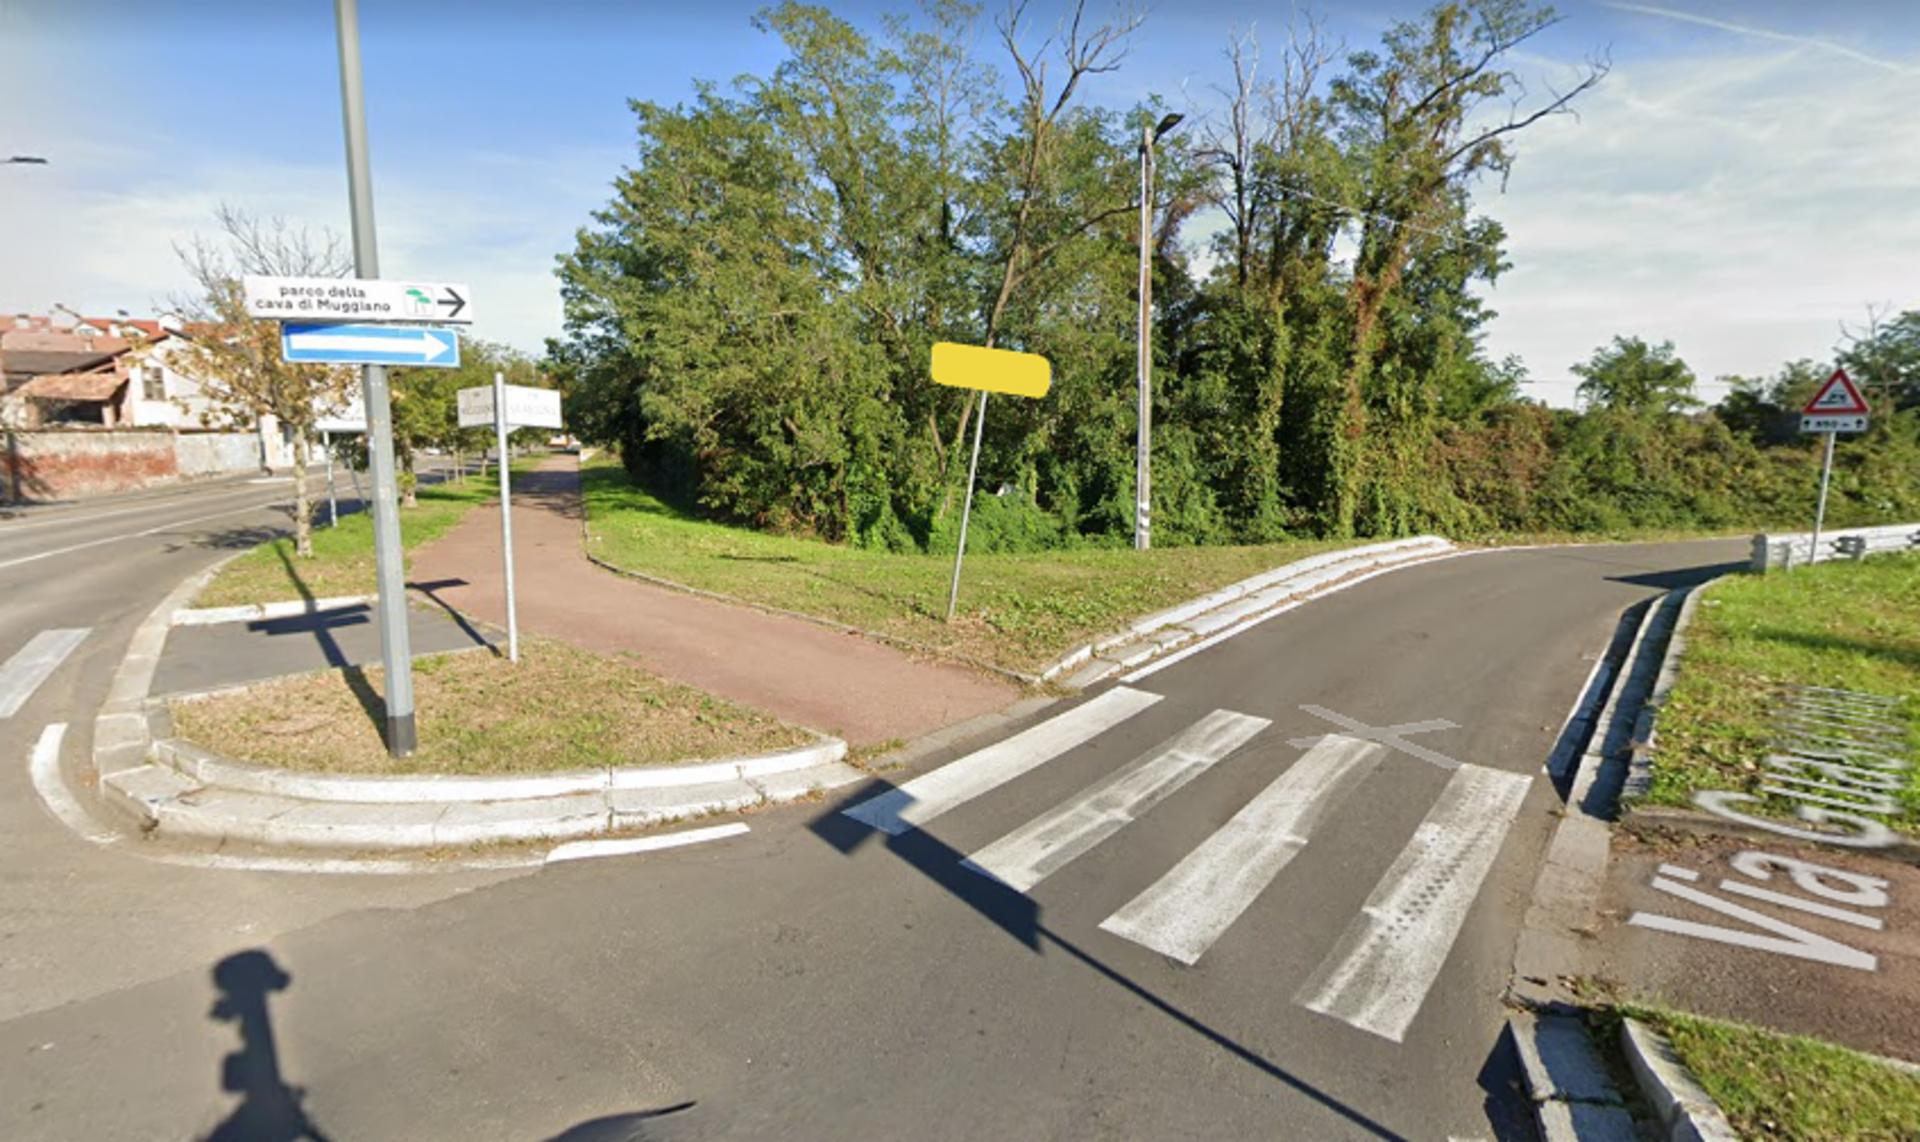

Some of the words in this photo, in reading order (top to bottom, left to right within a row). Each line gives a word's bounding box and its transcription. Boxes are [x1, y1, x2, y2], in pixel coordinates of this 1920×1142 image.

[280, 287, 325, 298] parco
[328, 287, 366, 298] della
[255, 299, 293, 310] cava
[298, 299, 313, 310] di
[317, 299, 391, 313] Muggiano
